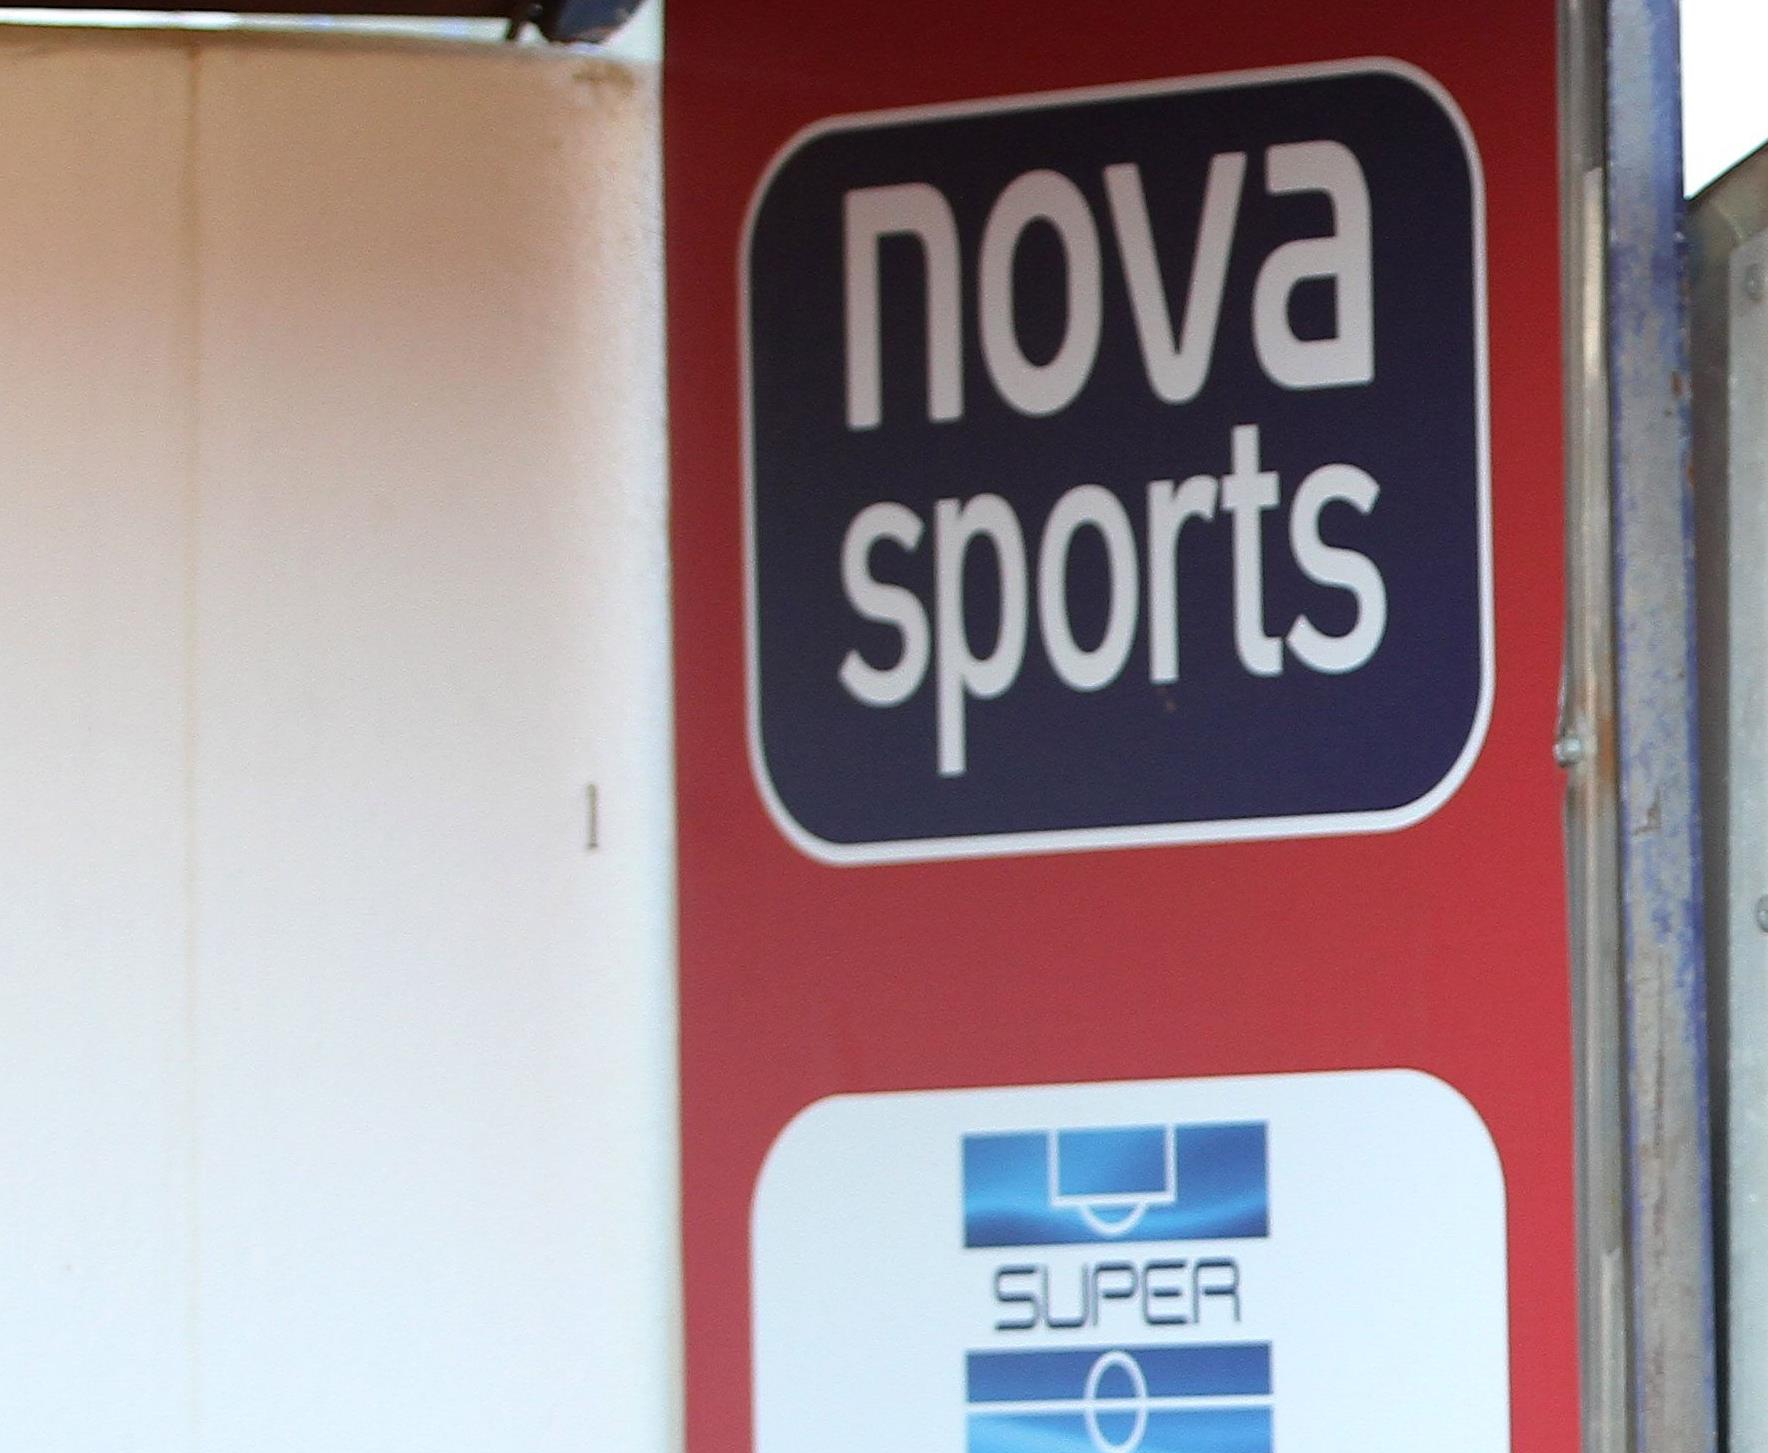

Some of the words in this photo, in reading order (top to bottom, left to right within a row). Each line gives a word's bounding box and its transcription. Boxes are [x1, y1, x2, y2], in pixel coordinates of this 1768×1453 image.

[843, 139, 1376, 431] nova
[837, 423, 1388, 778] sports
[994, 1257, 1242, 1330] SUPER
